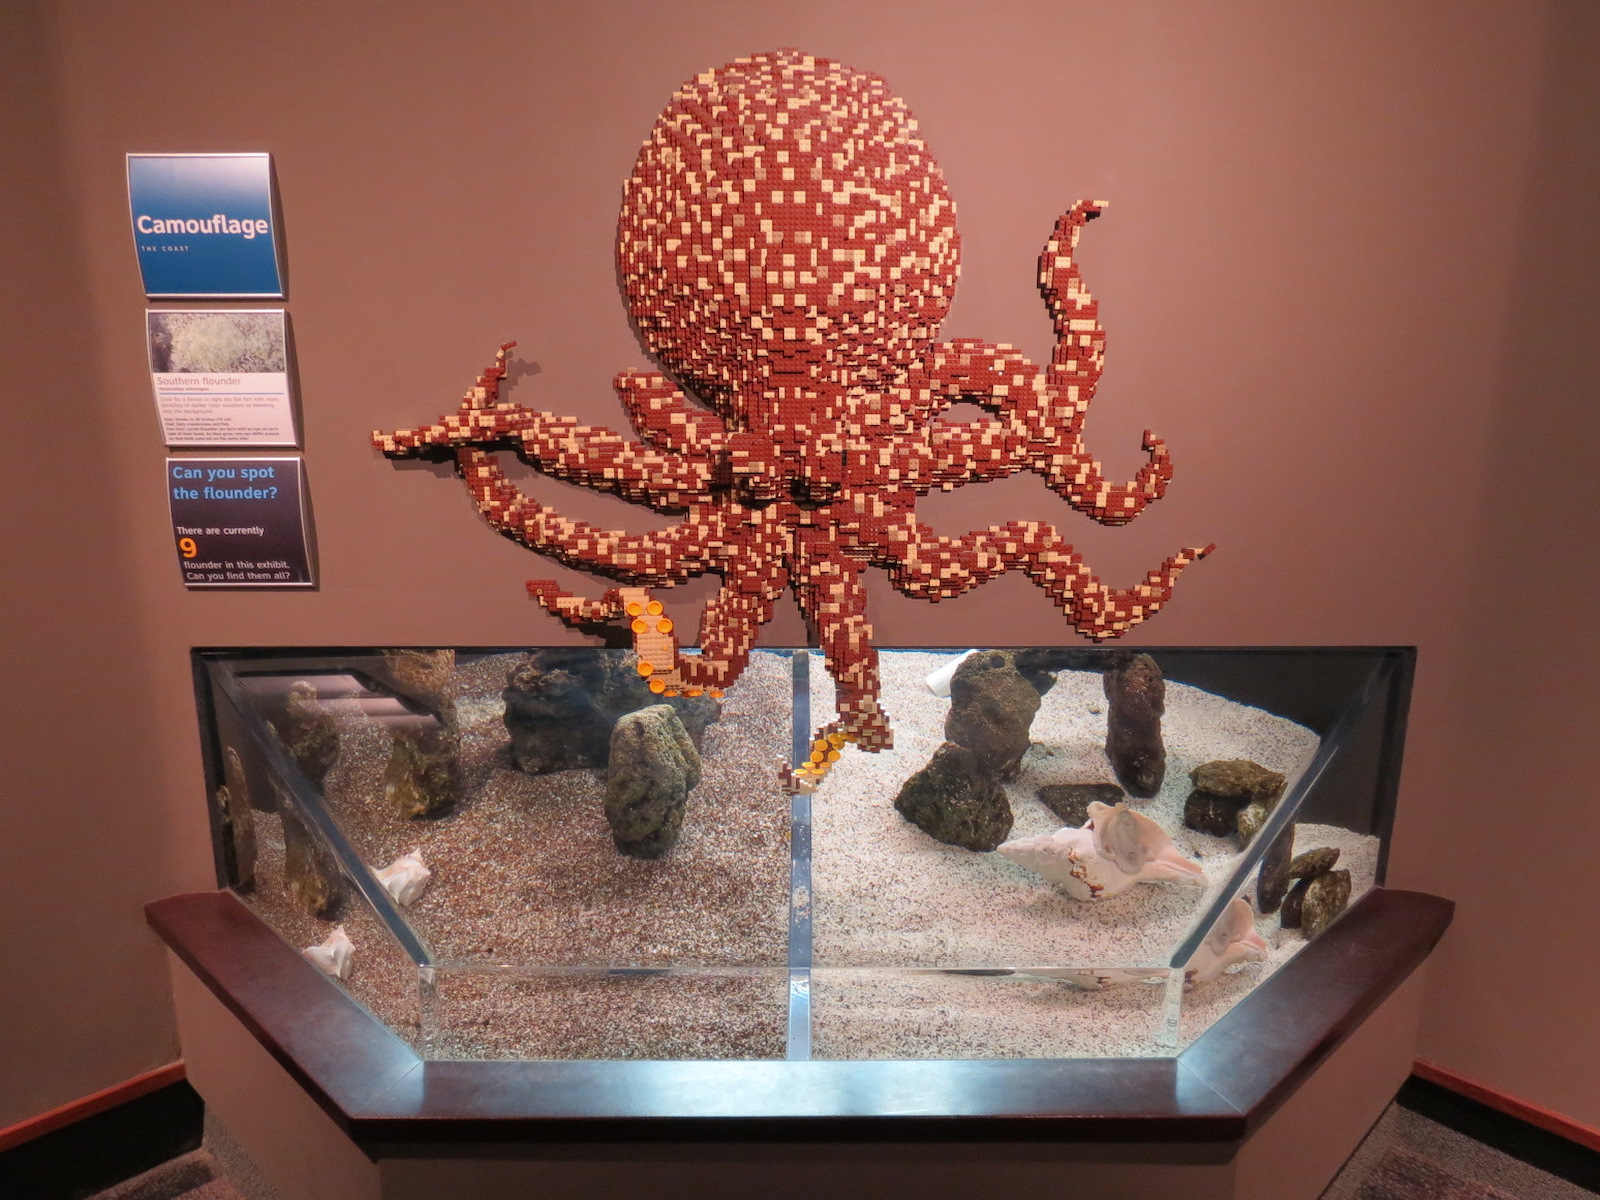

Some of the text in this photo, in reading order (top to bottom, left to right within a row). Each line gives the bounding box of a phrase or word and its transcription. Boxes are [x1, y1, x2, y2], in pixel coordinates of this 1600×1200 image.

[137, 214, 268, 239] Camouflage
[157, 376, 240, 385] Southern flounder
[172, 466, 274, 482] Can you spot
[173, 486, 277, 499] the flounder?
[176, 526, 202, 535] There
[223, 526, 264, 537] currently
[179, 537, 198, 558] 9
[183, 561, 290, 569] flounder in this exhibit.
[187, 571, 290, 581] Can you find them all?
